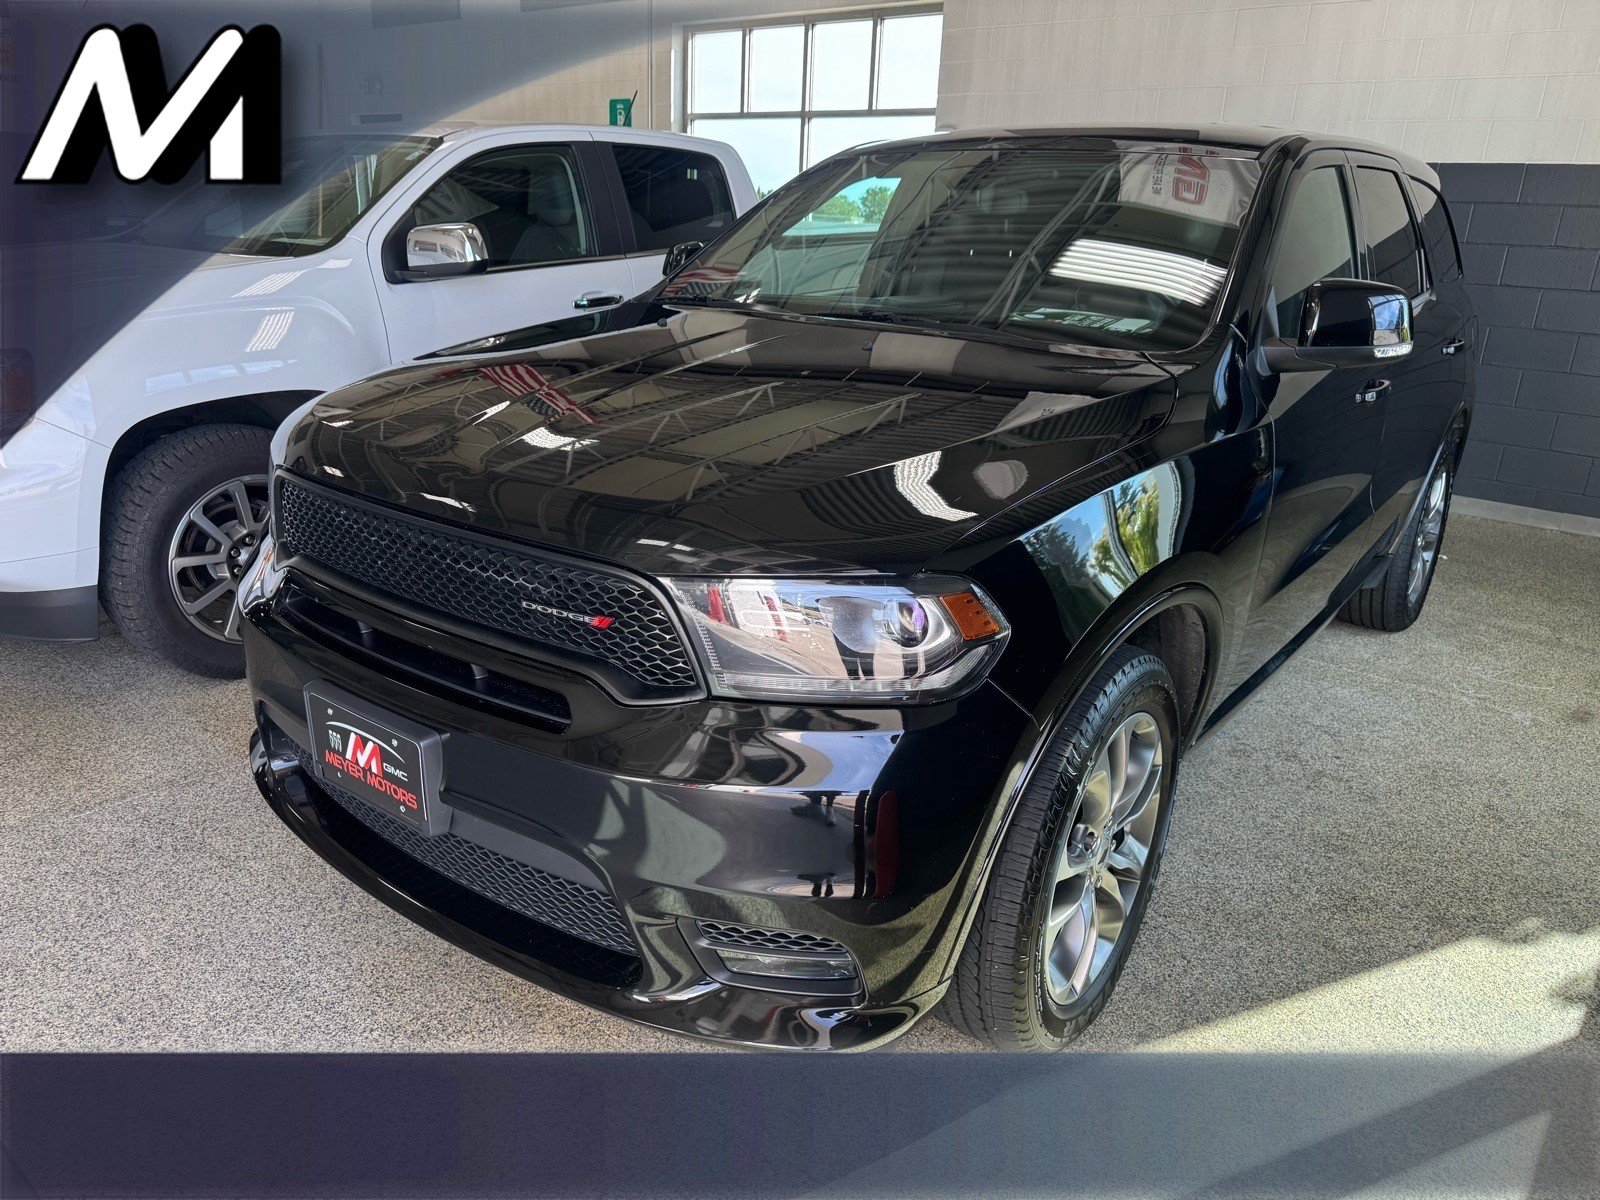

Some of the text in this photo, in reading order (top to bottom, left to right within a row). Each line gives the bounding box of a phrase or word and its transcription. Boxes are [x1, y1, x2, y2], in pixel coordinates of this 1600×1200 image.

[521, 601, 596, 624] DODGE
[325, 749, 418, 810] MEYER MOTORS
[383, 762, 409, 782] GMC
